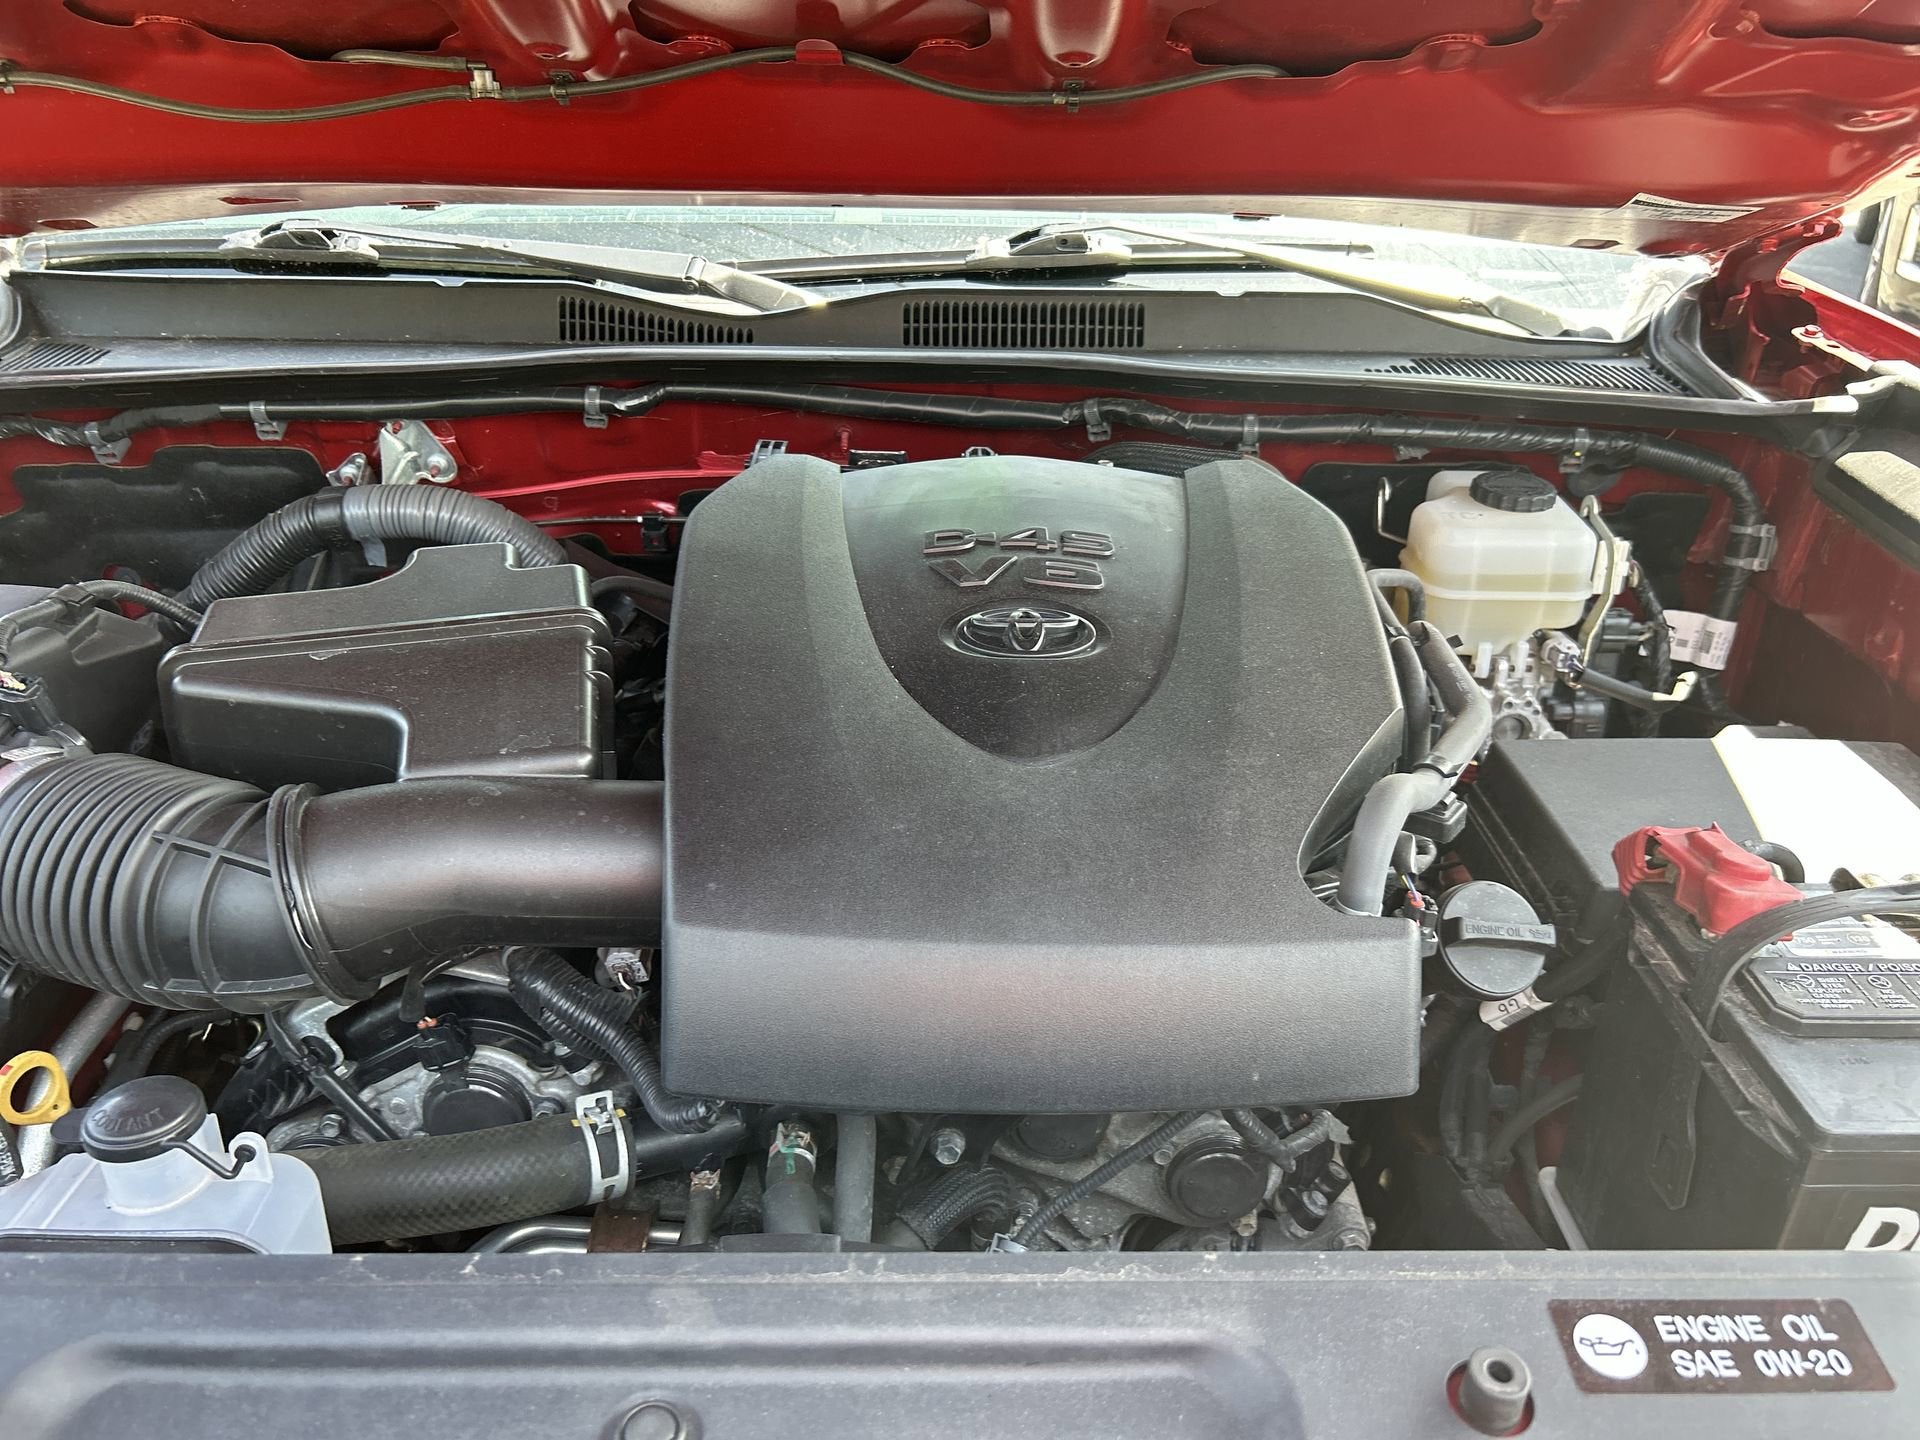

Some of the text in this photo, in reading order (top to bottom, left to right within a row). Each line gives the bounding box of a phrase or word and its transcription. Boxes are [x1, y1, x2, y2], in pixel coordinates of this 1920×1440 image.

[923, 526, 1115, 556] D-4S
[927, 555, 1105, 590] V6
[1465, 923, 1525, 938] ENGINE OIL
[1801, 962, 1866, 973] DANGER
[91, 1106, 166, 1132] COOLANT
[1845, 1206, 1920, 1251] D
[1653, 1313, 1839, 1342] ENGINE OIL
[1670, 1348, 1854, 1378] SAE 0W-20
